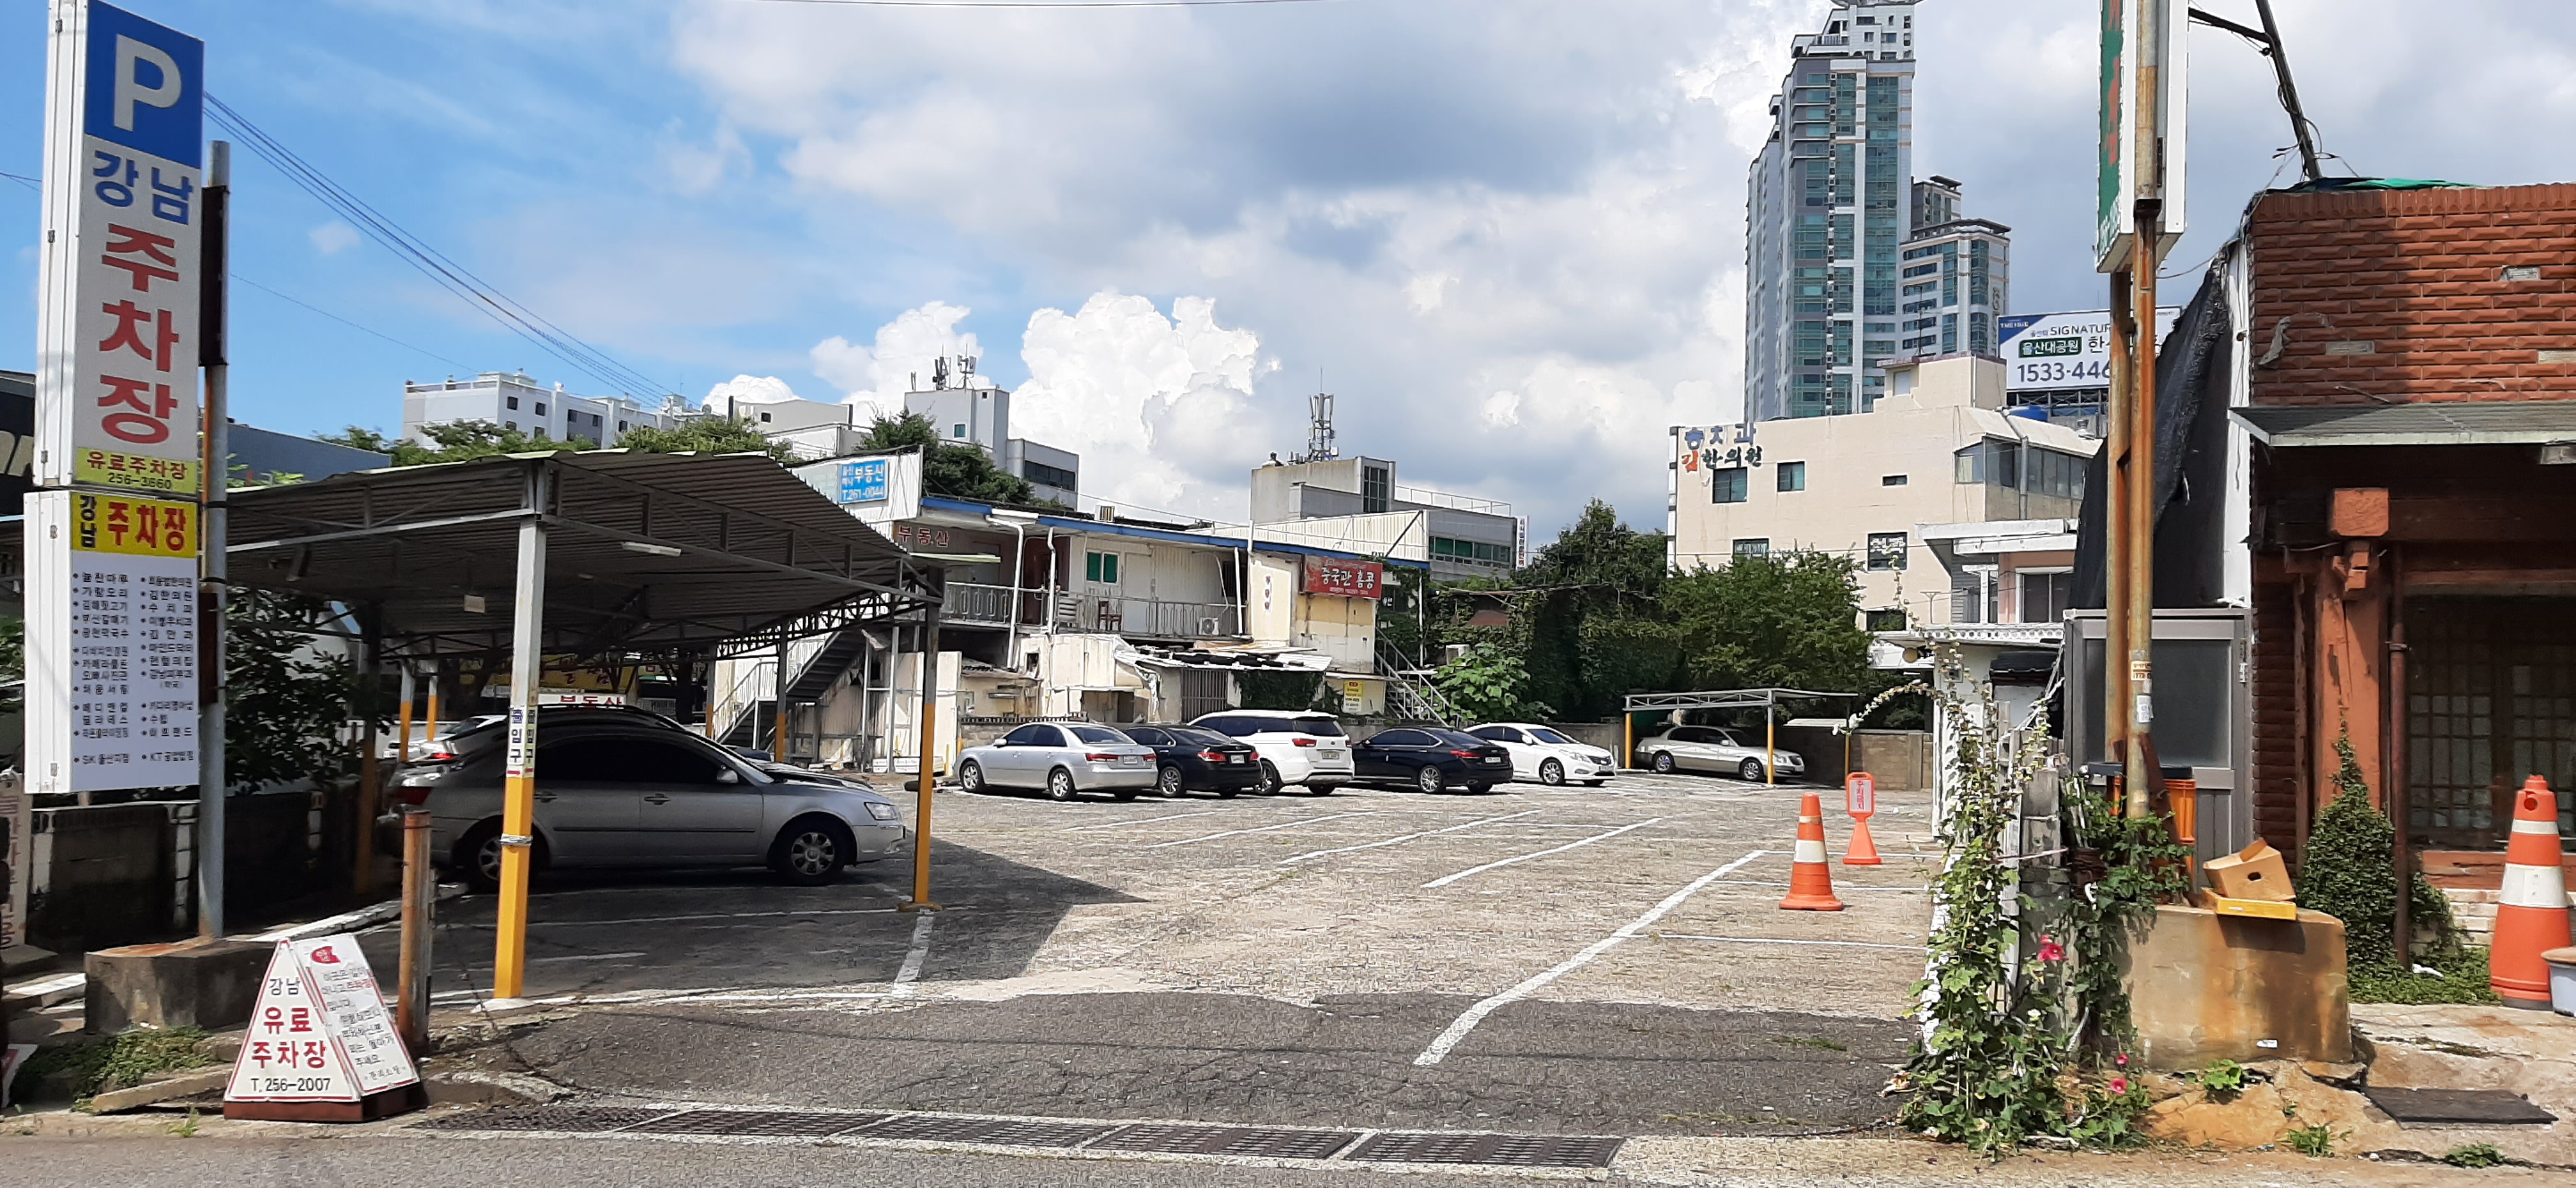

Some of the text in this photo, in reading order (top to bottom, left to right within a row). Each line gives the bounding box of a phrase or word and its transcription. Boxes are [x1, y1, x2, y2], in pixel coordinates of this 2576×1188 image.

[113, 34, 182, 132] P
[93, 151, 193, 225] 강남
[98, 223, 179, 445] 주차장
[2023, 340, 2078, 355] 울산대공원
[87, 451, 187, 480] 유료주차장
[1682, 445, 1763, 473] 김한의원
[855, 464, 884, 484] 부동산
[80, 495, 97, 548] 강남
[108, 502, 187, 551] 주차장
[898, 525, 949, 547] 부동산
[1321, 567, 1375, 589] 중국관 홍콩
[268, 978, 301, 996] 강남
[263, 1007, 312, 1035] 유료
[251, 1040, 326, 1069] 주차장
